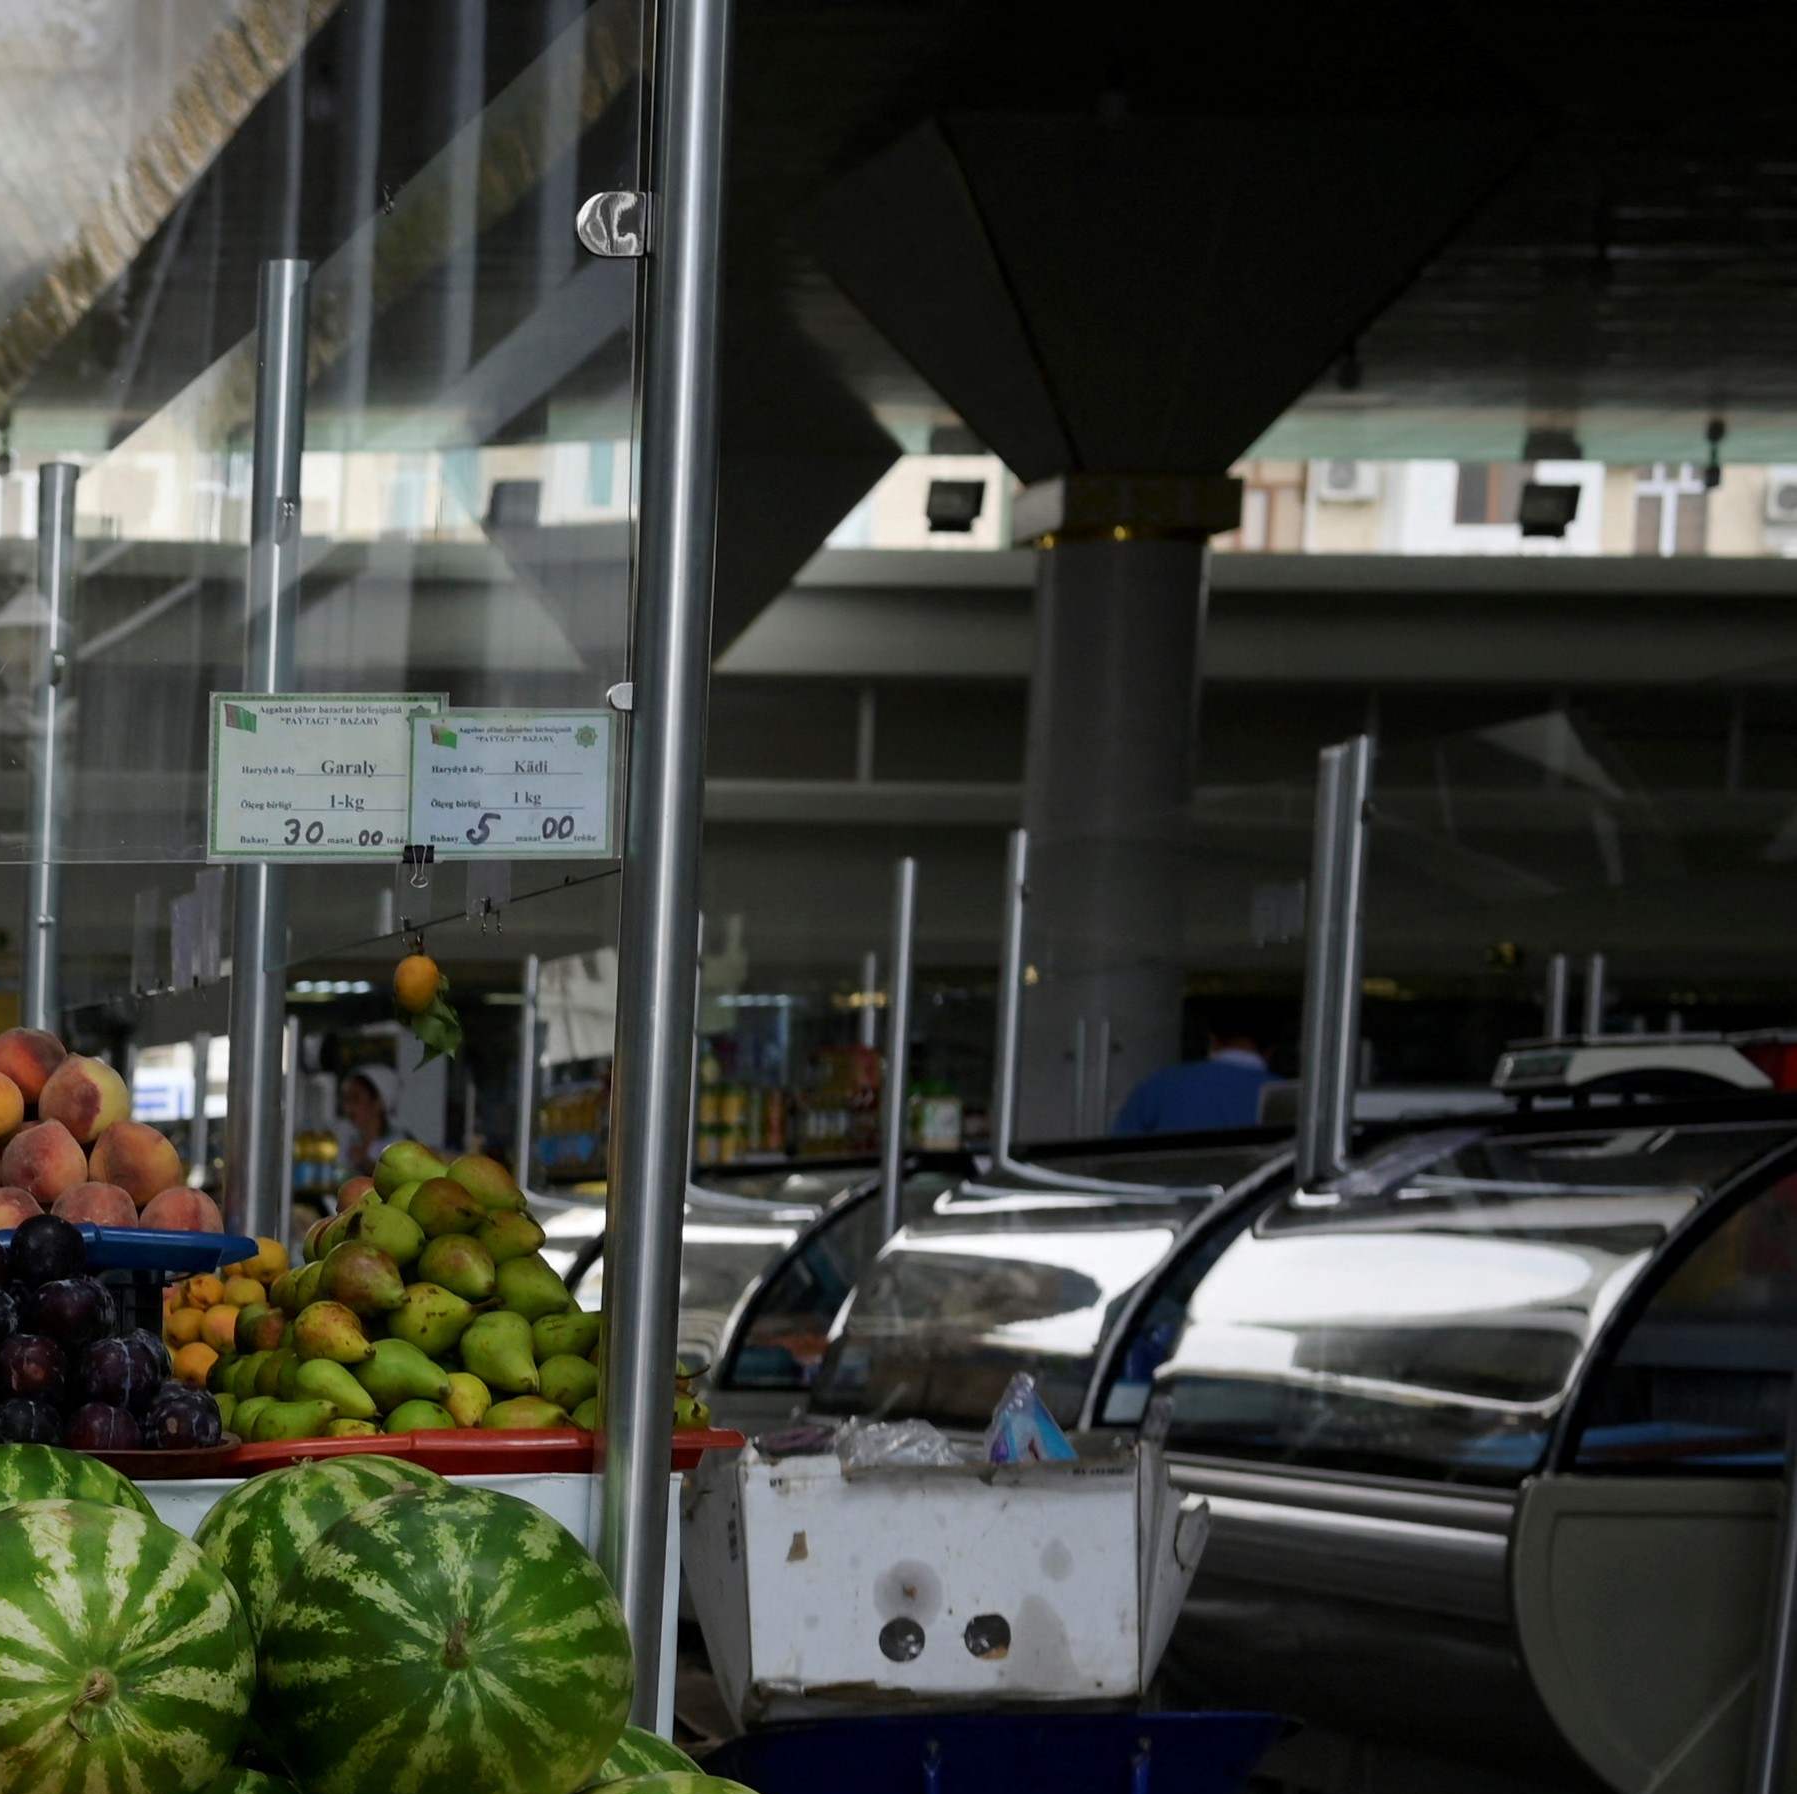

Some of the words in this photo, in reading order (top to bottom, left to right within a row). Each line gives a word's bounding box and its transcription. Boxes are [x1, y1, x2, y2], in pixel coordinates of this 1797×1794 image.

[340, 716, 379, 726] BAZARY
[321, 760, 377, 778] Garaly
[330, 794, 365, 812] 1-kg
[514, 791, 519, 804] 1
[525, 791, 542, 806] kg
[284, 818, 324, 846] 30
[358, 829, 384, 847] 00
[466, 812, 501, 846] 5
[542, 815, 575, 840] 00
